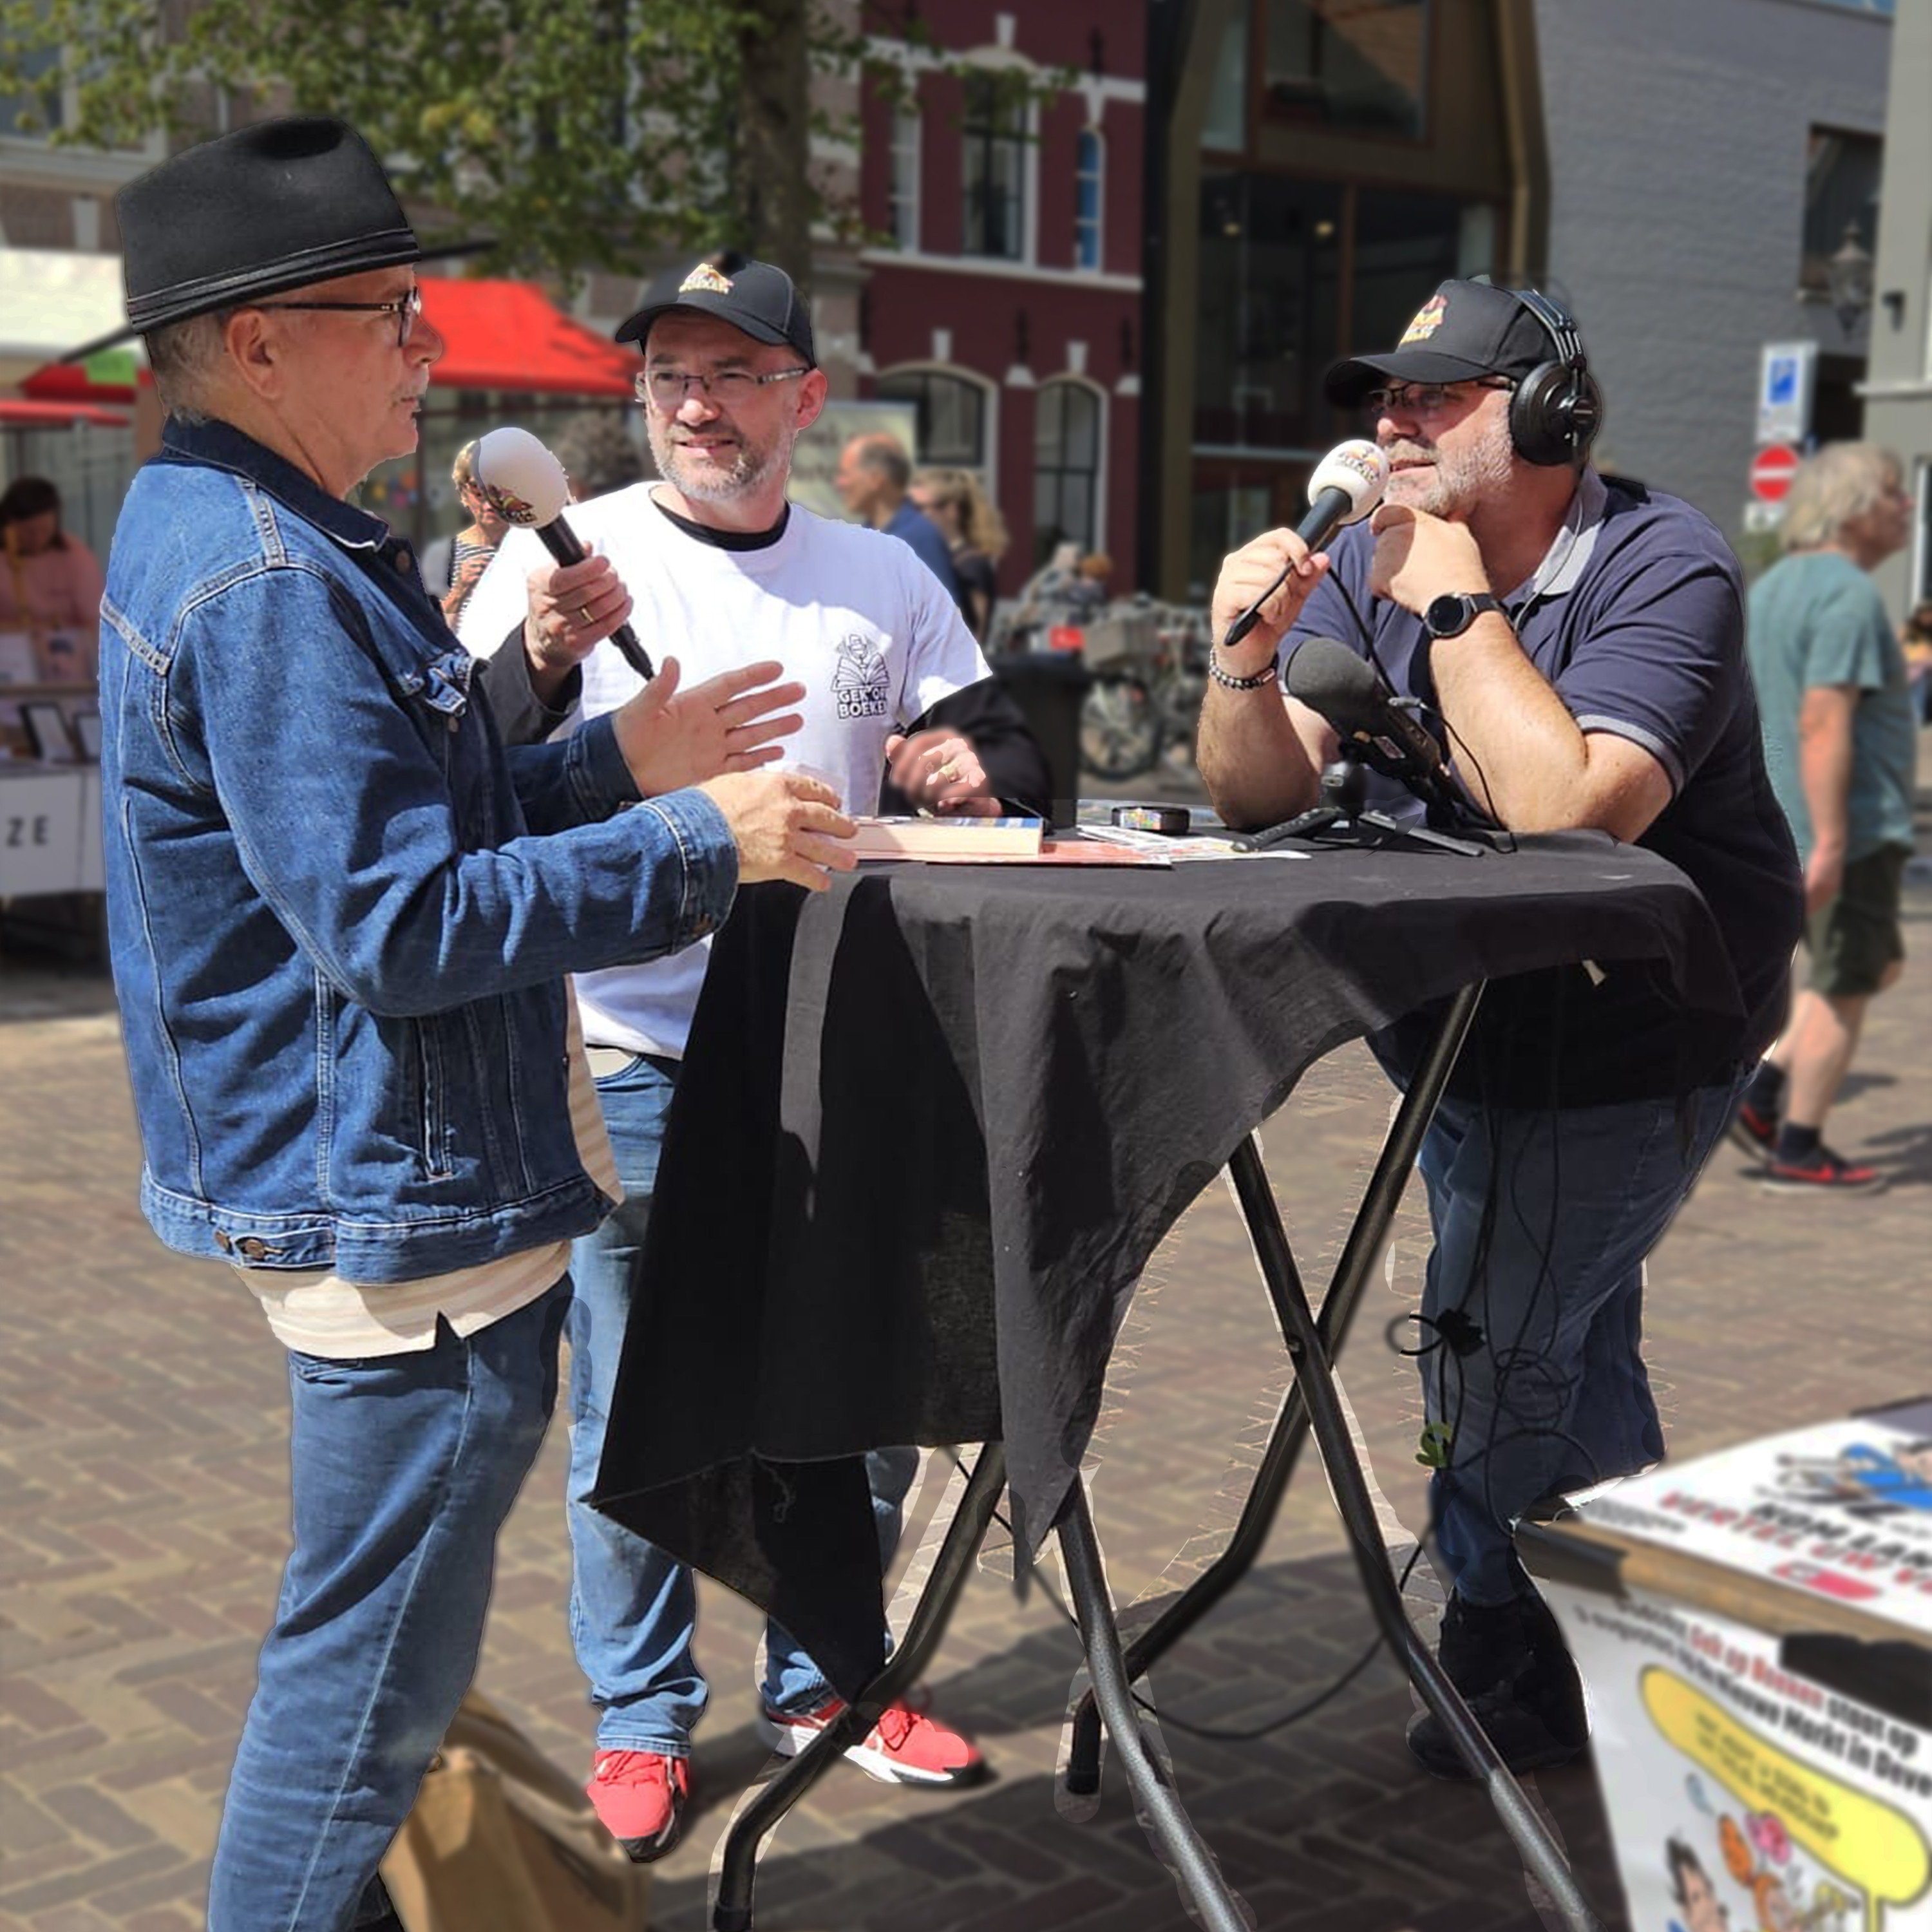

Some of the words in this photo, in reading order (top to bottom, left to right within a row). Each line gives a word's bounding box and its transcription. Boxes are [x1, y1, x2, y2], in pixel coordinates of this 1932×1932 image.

[838, 689, 869, 704] GEK
[1784, 1705, 1846, 1759] Markt
[1847, 1731, 1871, 1770] in
[1887, 1724, 1919, 1761] op
